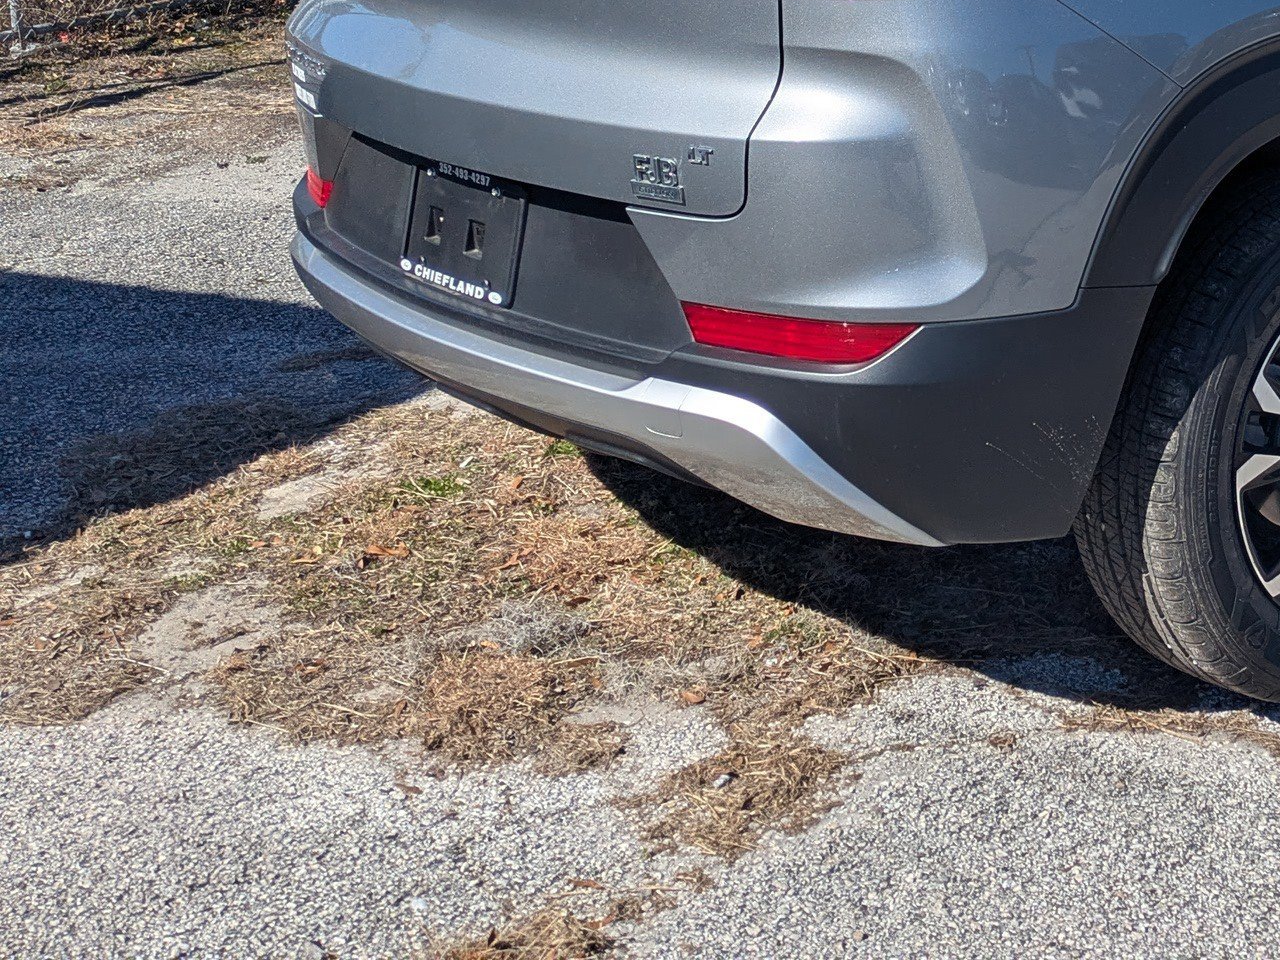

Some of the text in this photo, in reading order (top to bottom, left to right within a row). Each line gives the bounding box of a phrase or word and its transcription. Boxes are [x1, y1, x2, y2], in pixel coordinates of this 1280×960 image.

[687, 144, 715, 166] LT
[438, 162, 491, 187] 352-493-4297
[414, 263, 485, 300] CHIEFLAND
